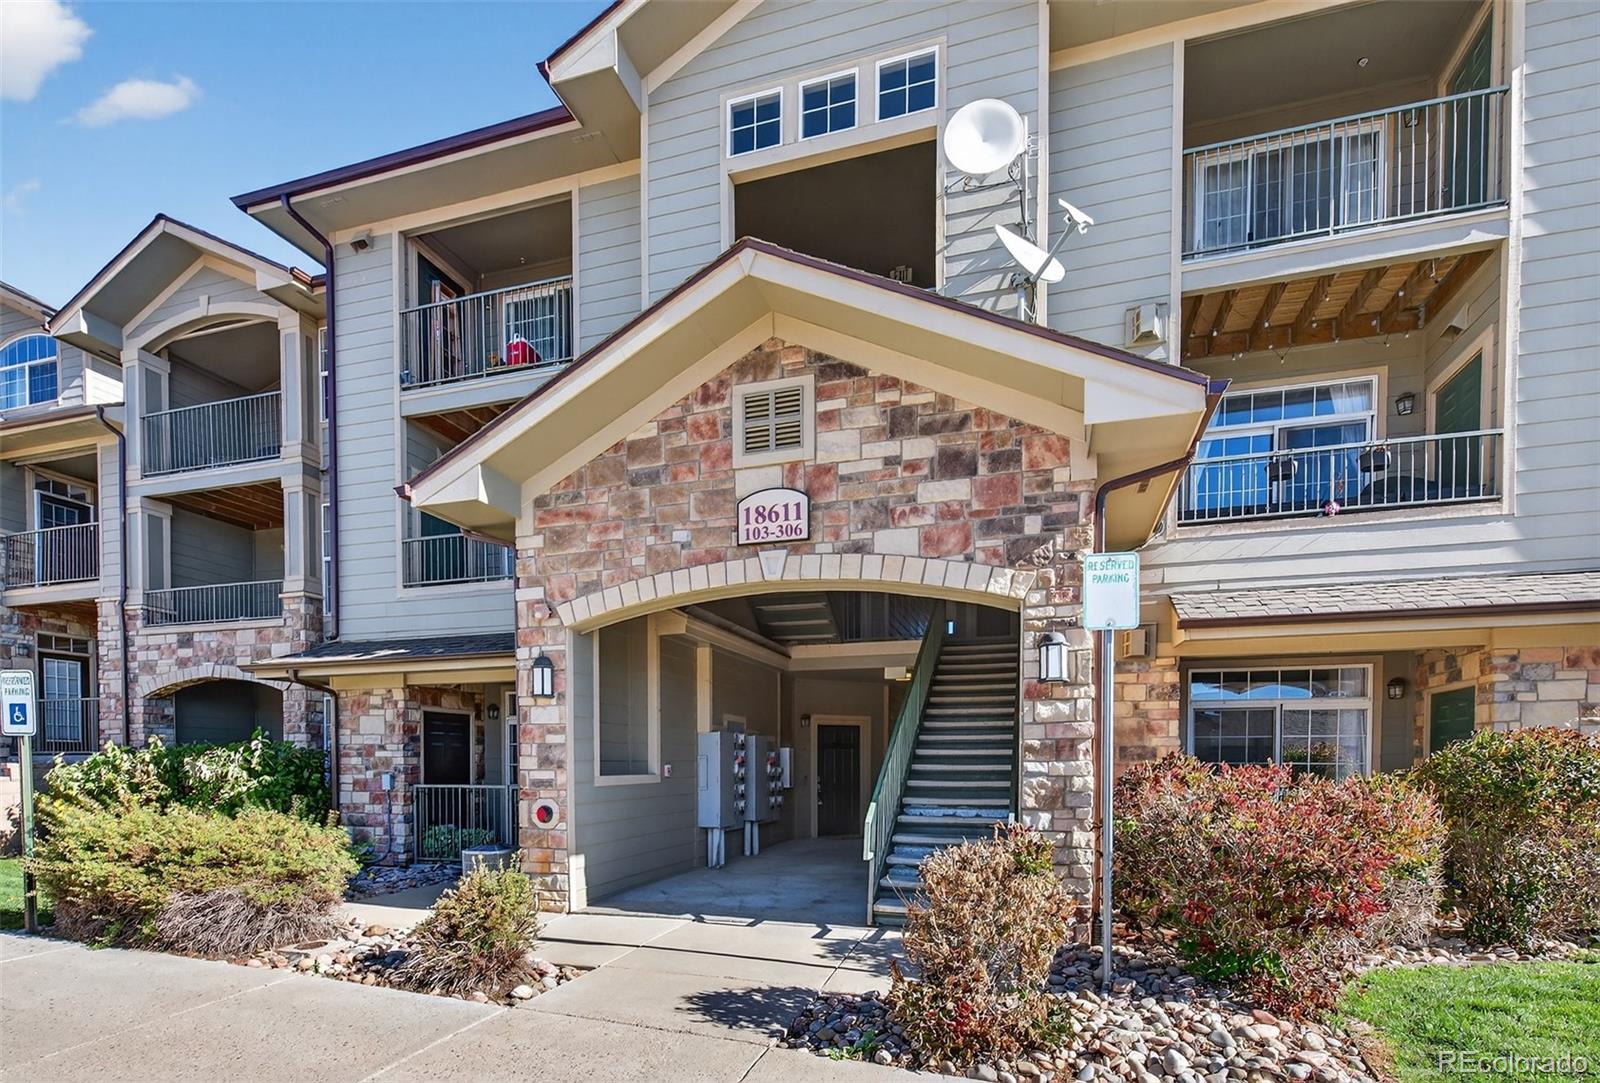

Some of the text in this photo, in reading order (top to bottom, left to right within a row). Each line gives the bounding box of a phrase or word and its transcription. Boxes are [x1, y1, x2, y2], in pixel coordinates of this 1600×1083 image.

[744, 502, 802, 525] 18611
[745, 523, 803, 540] 103-306
[1087, 560, 1134, 571] RESERVED
[1092, 573, 1129, 583] PARKING
